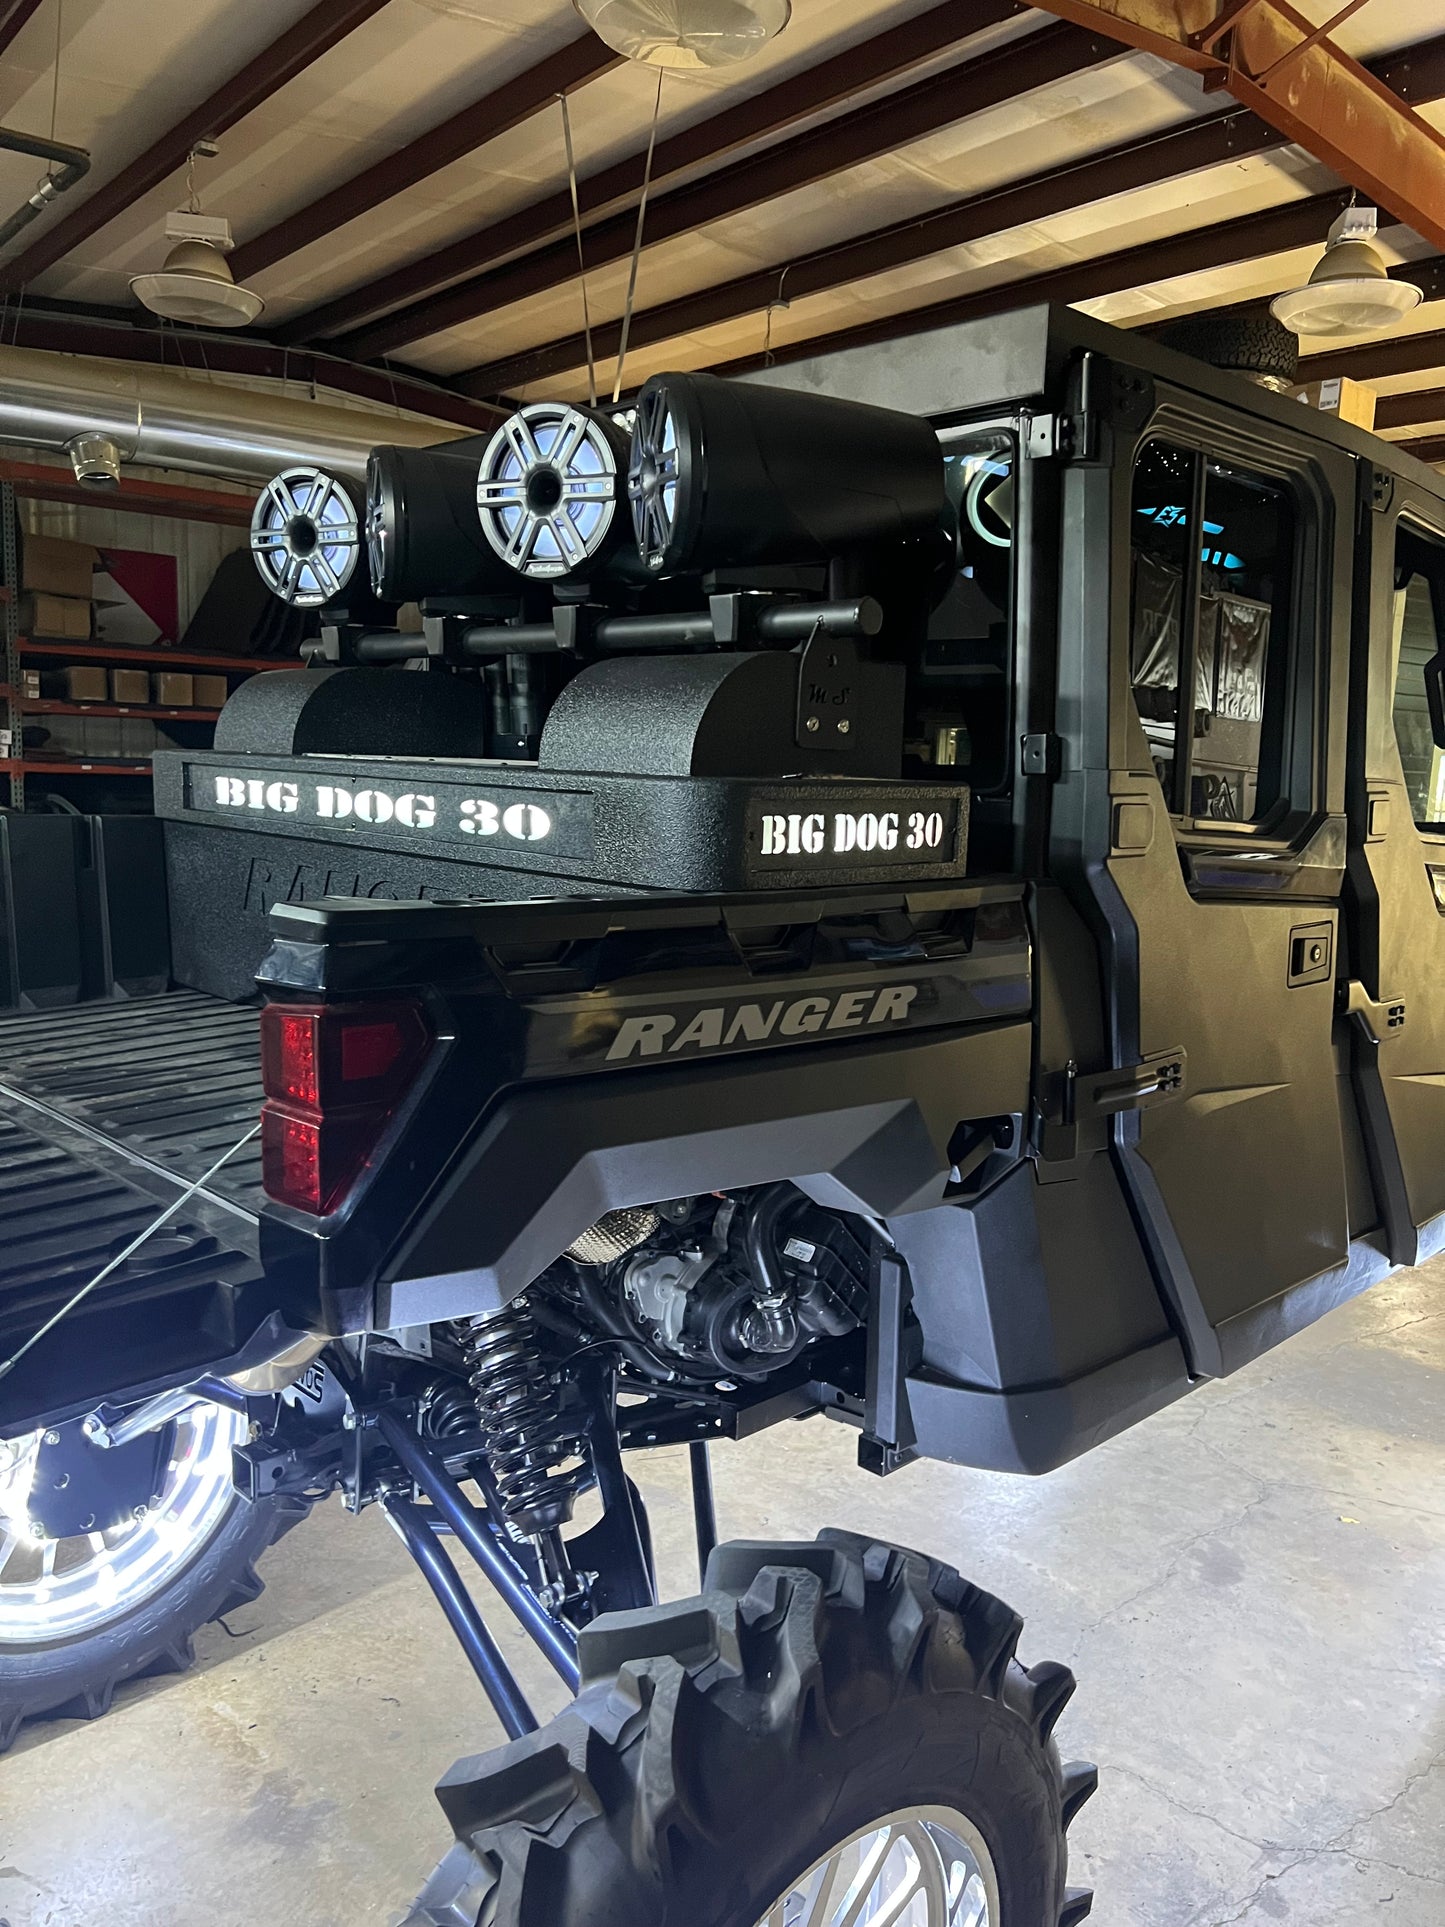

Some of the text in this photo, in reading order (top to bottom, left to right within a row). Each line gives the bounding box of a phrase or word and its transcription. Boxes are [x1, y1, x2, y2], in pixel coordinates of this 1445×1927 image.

[215, 775, 551, 841] BIG DOG 30
[761, 812, 943, 855] BIG DOG 30
[605, 985, 918, 1060] RANGER
